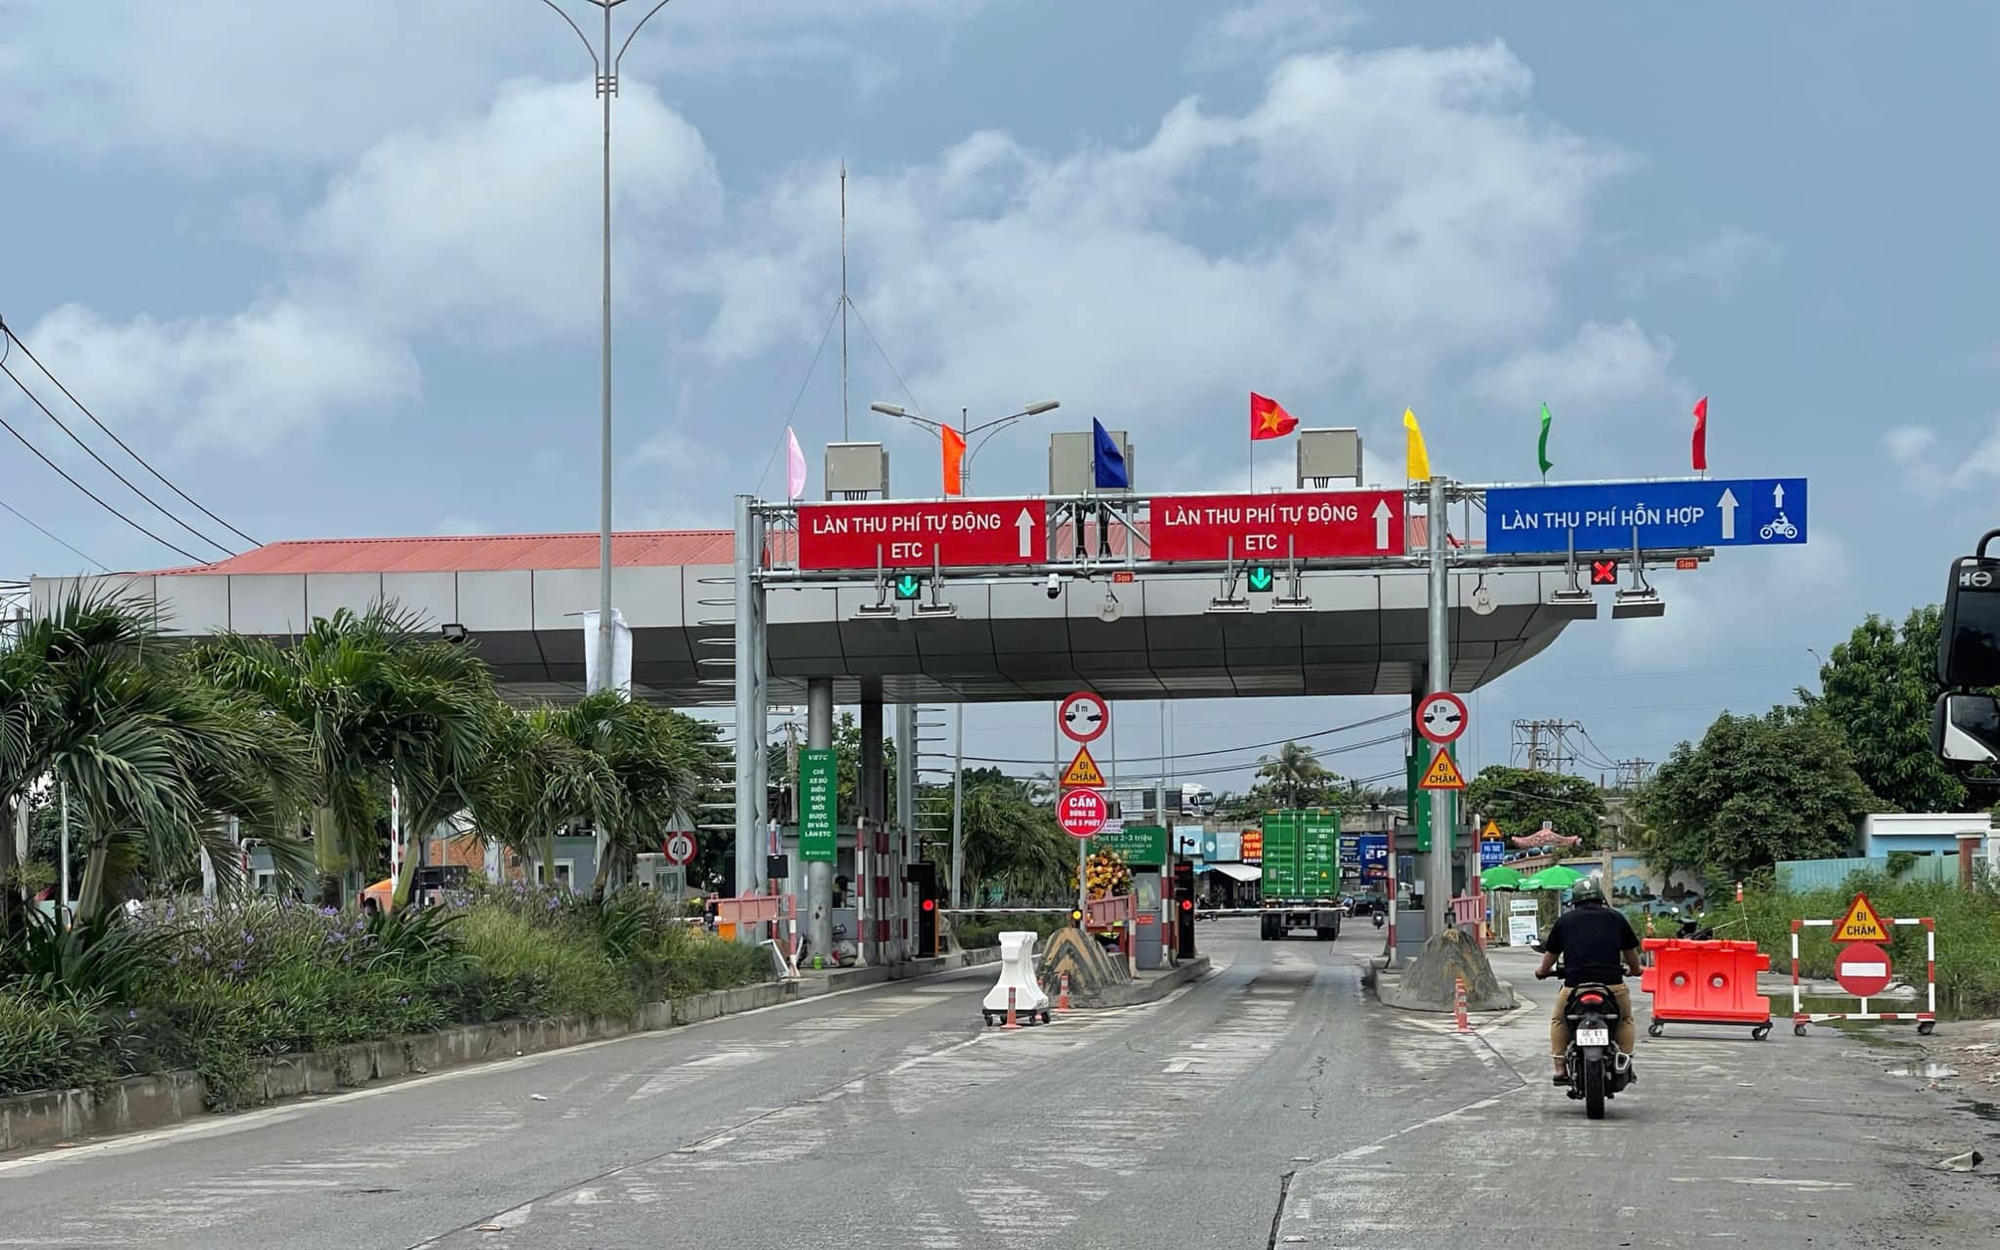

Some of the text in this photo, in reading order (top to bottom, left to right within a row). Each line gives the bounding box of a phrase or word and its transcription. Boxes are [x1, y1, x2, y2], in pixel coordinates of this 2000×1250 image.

[1165, 503, 1358, 526] LÀN THU PHÍ TỰ ĐỘNG
[1502, 502, 1704, 530] LÀN THU PHÍ HỖN HỢP
[813, 512, 1001, 534] LÀN THU PHÍ TỰ ĐỘNG
[1246, 533, 1278, 550] ETC
[891, 542, 923, 558] ETC
[1079, 761, 1089, 770] ĐI
[1438, 763, 1448, 772] ĐI
[1069, 795, 1096, 808] CẤM
[672, 841, 687, 855] 40
[1856, 911, 1867, 921] ĐI
[1846, 923, 1877, 938] CHẬM
